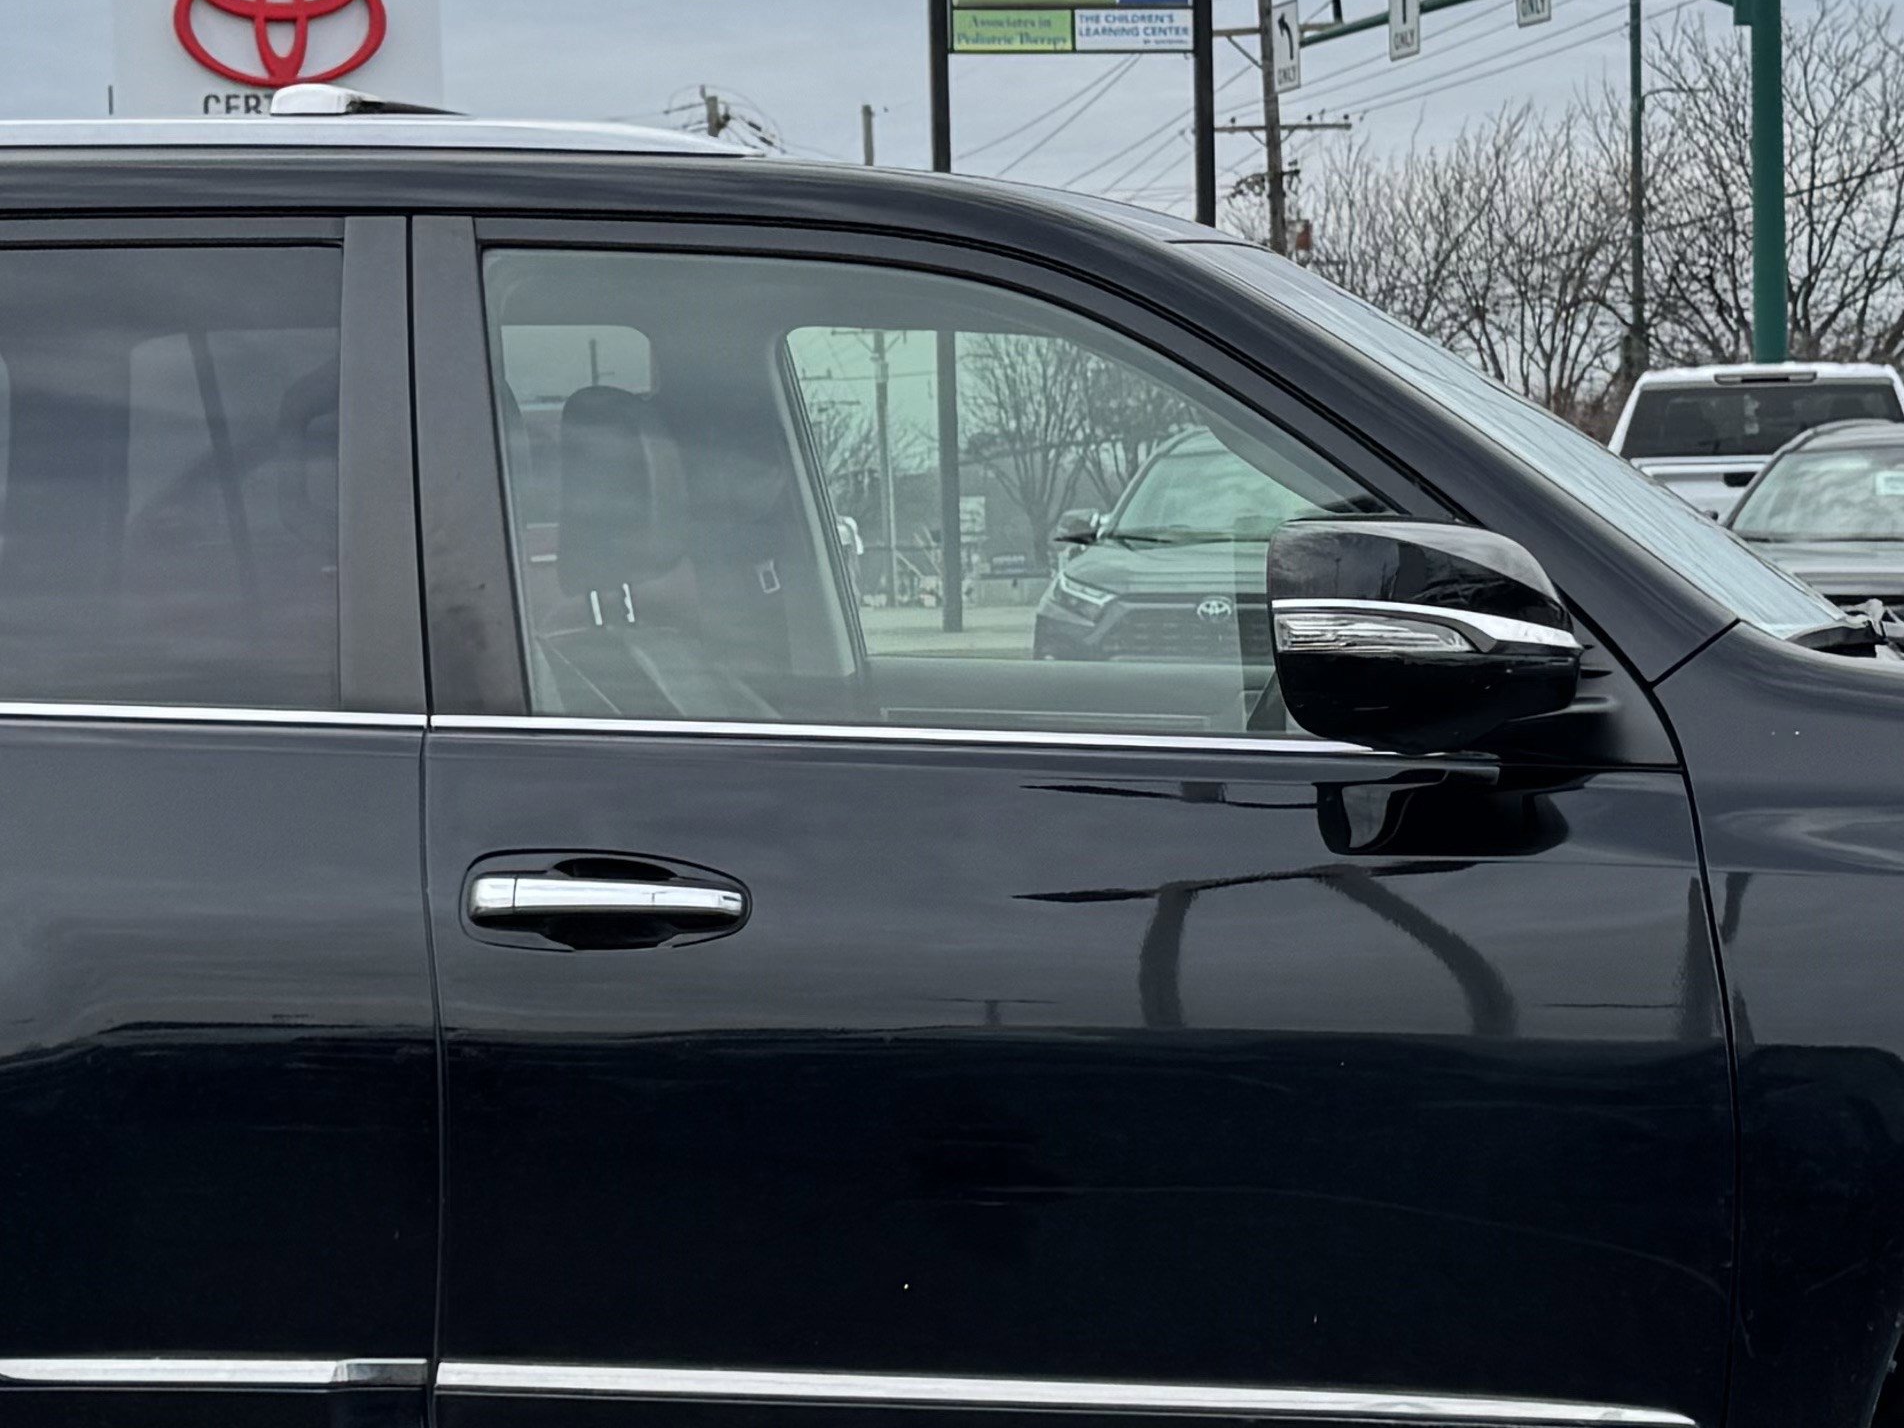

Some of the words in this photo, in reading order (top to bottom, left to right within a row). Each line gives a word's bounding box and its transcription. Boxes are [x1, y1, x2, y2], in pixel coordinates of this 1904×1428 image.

[1079, 14, 1100, 24] THE
[1104, 14, 1174, 25] CHILDREN'S
[1079, 26, 1140, 37] LEARNING
[1143, 26, 1189, 37] CENTER
[1394, 29, 1415, 51] ONLY
